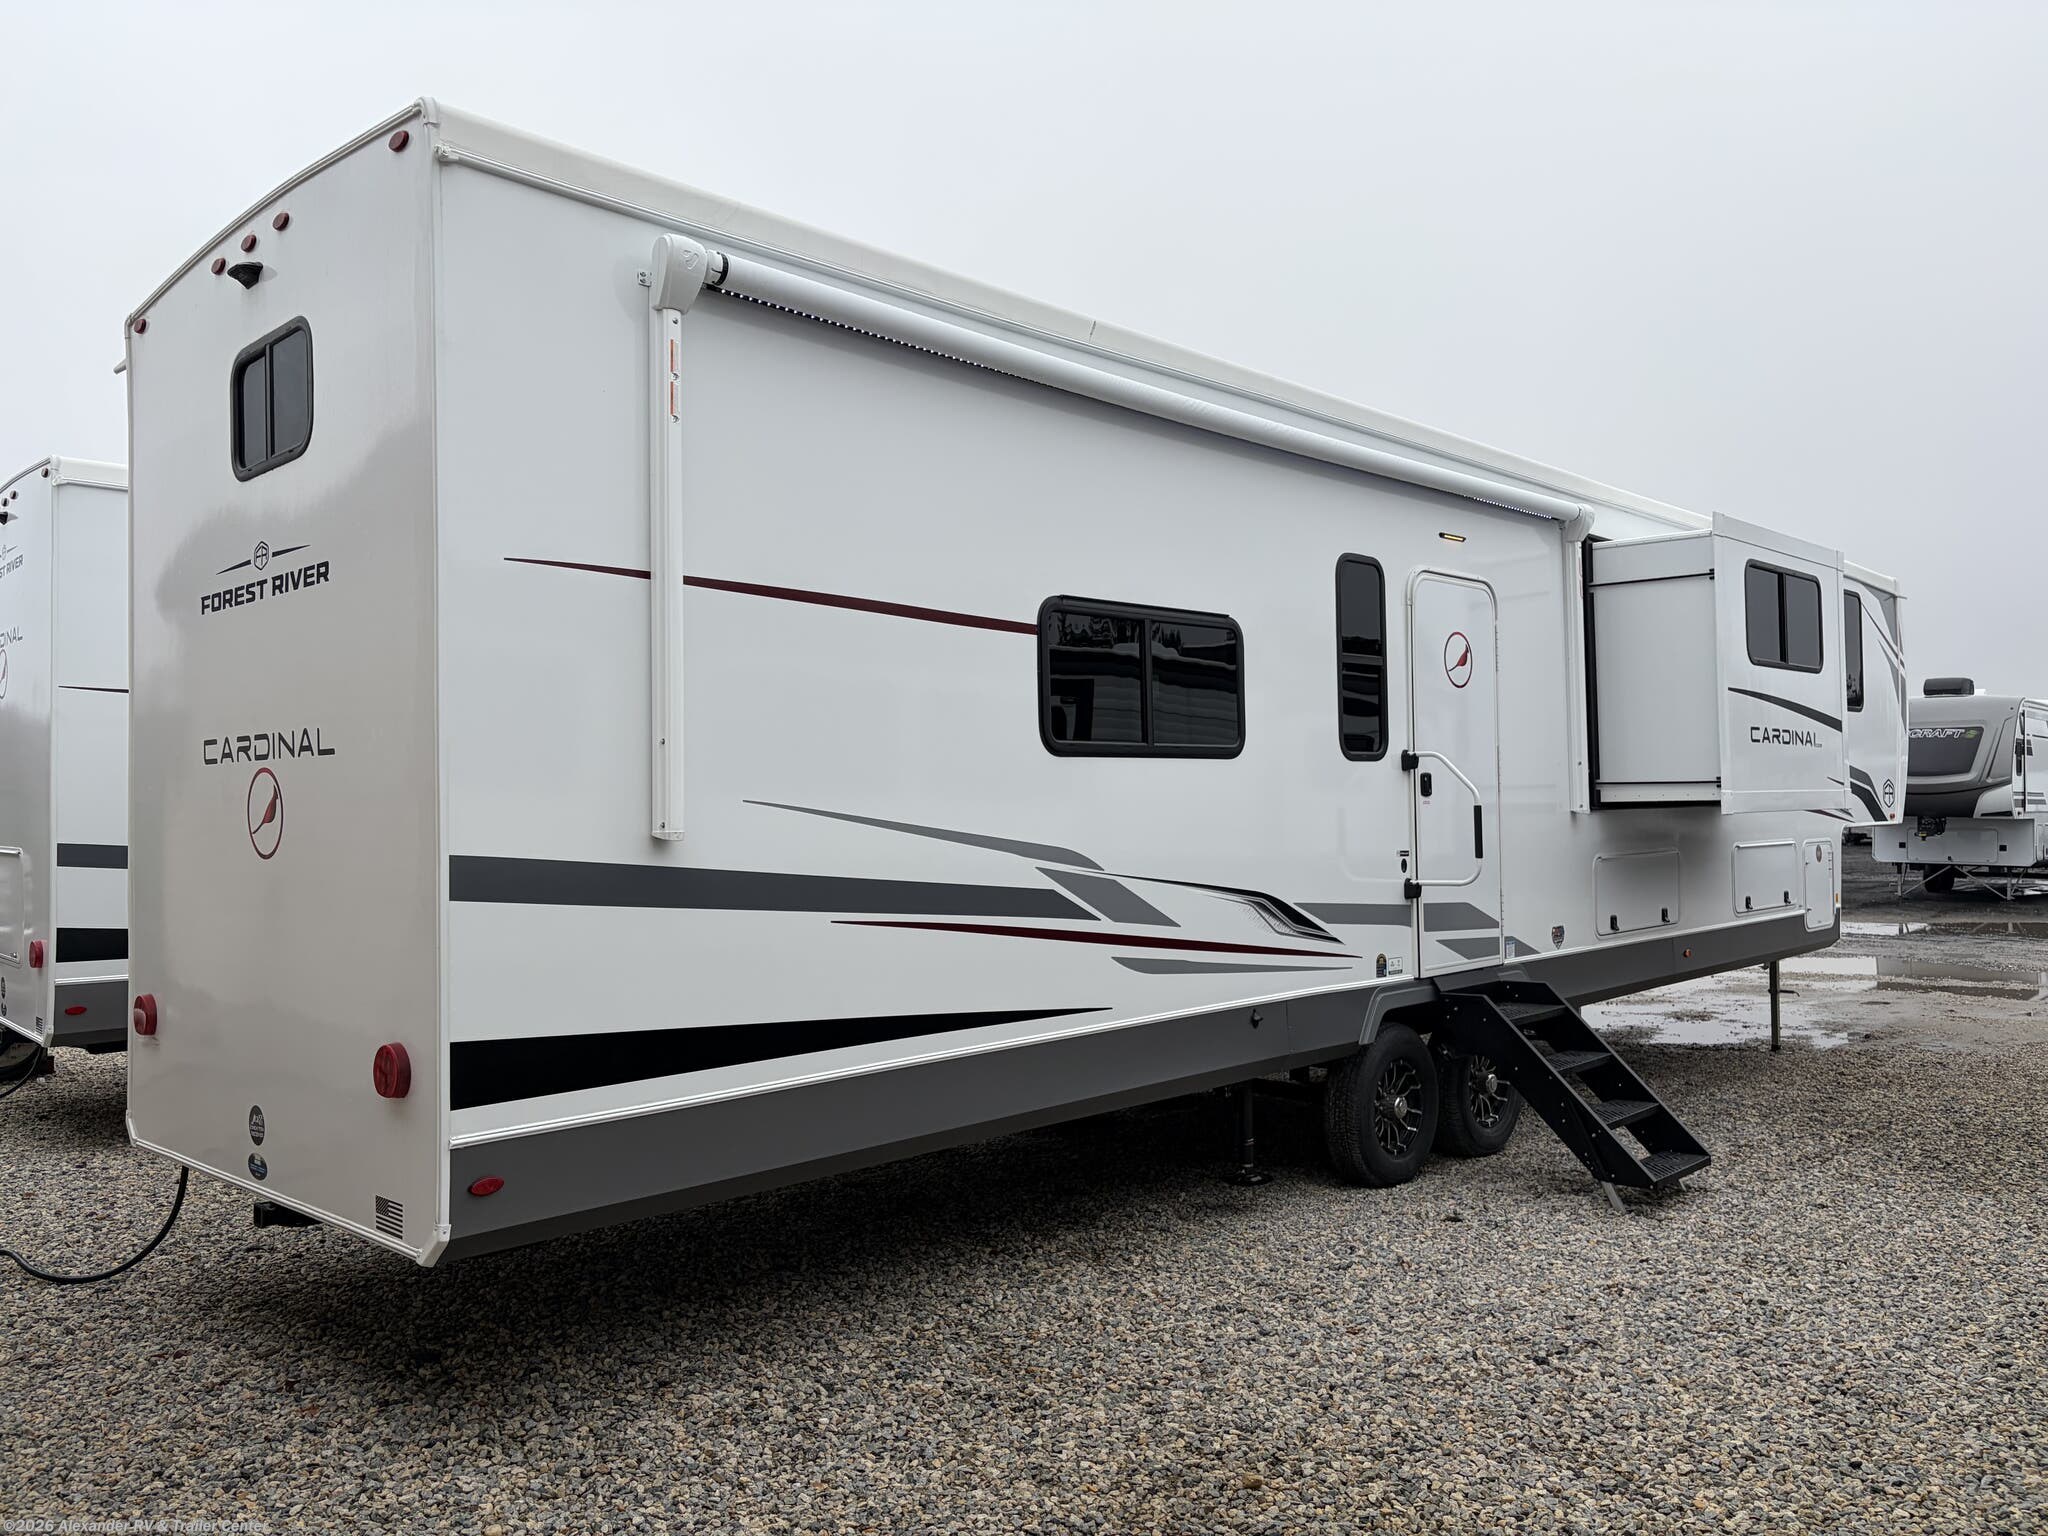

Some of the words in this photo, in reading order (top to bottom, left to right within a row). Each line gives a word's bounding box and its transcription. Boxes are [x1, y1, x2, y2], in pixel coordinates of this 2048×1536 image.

[6, 554, 23, 574] RIVER
[200, 578, 268, 615] FOREST
[271, 560, 330, 597] RIVER
[203, 727, 336, 765] CARDINAL
[1750, 726, 1823, 748] CARDINAL
